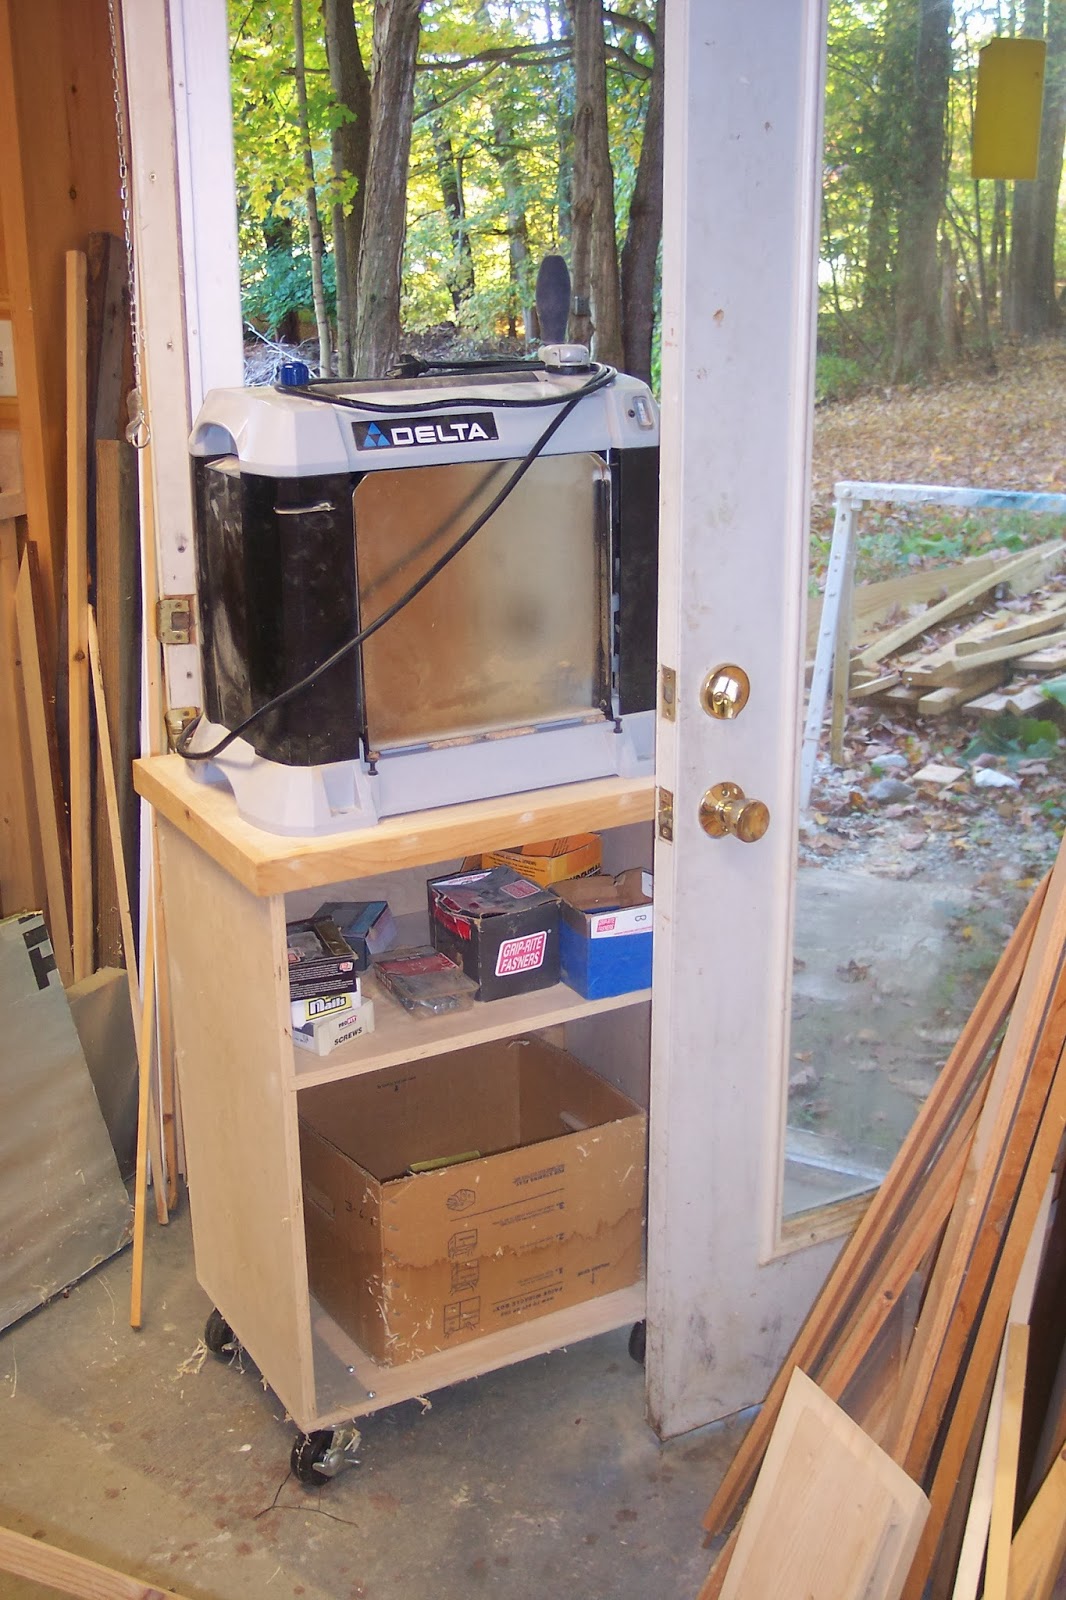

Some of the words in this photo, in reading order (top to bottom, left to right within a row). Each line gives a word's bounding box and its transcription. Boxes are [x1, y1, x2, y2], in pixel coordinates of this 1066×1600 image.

[391, 422, 489, 445] DELTA
[503, 935, 543, 957] GRIP-RITE
[334, 1027, 363, 1045] SCREWS
